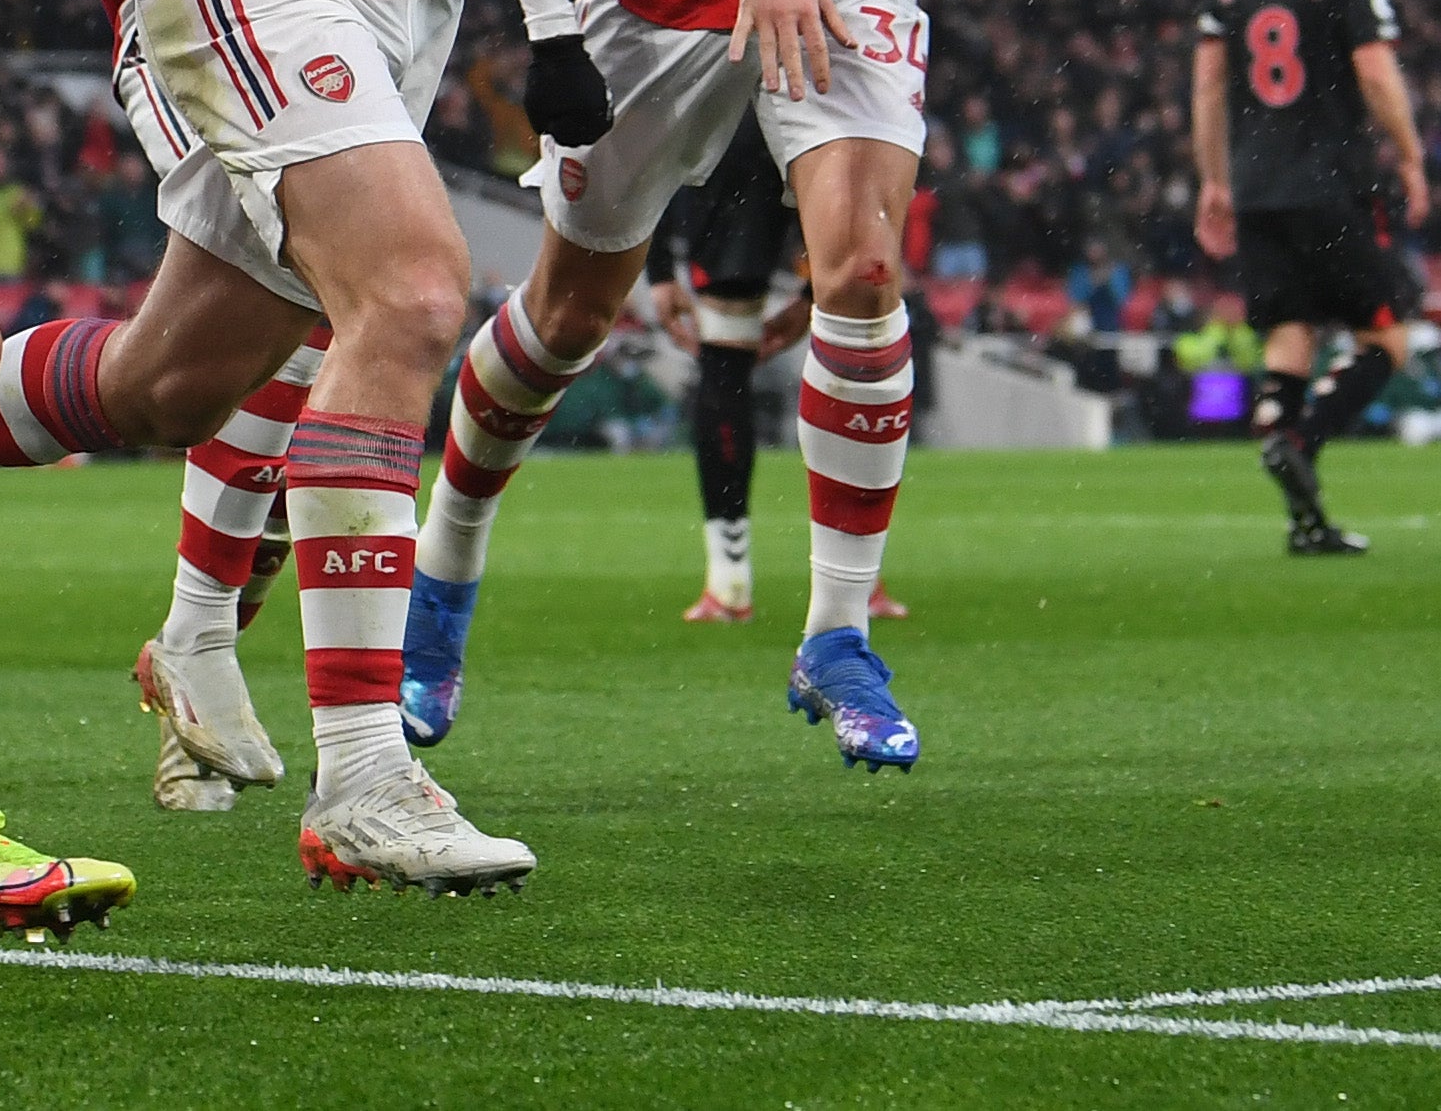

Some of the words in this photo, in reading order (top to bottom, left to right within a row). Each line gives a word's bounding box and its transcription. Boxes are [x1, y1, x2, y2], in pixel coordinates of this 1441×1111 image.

[1245, 5, 1305, 107] 8
[844, 410, 908, 433] AFC
[322, 550, 399, 574] AFC
